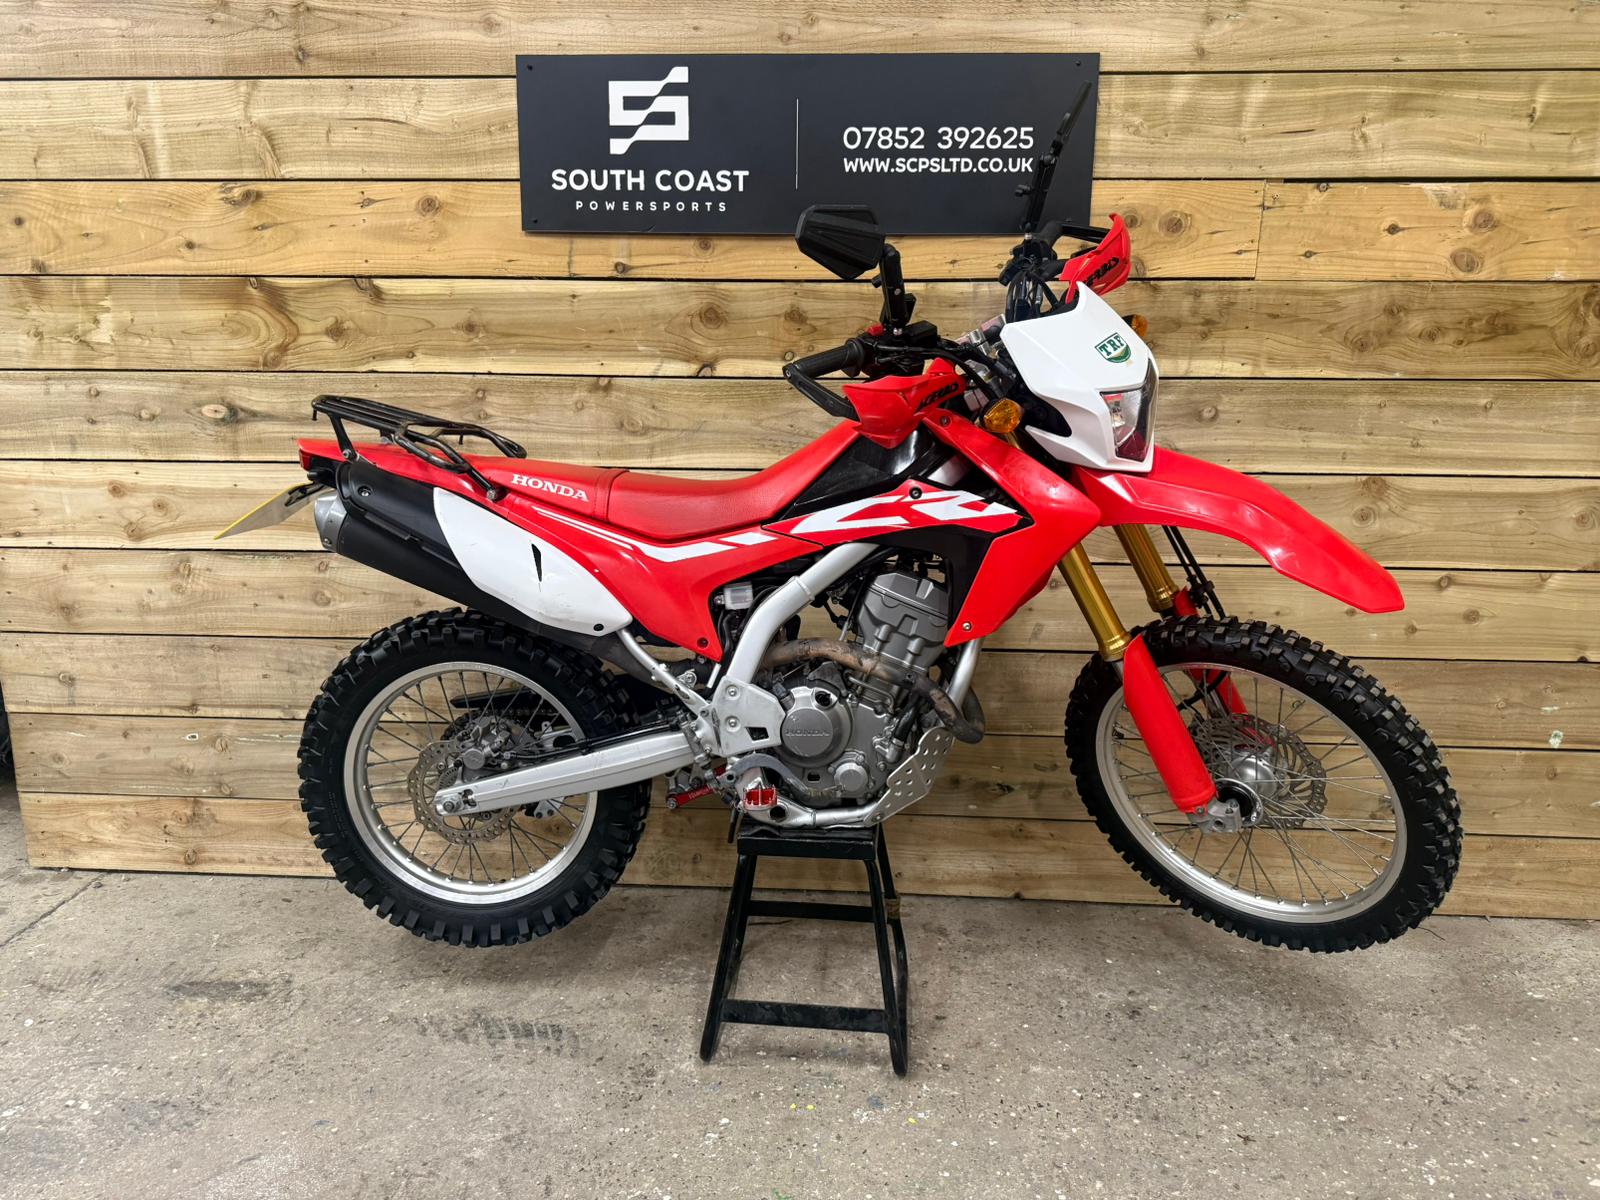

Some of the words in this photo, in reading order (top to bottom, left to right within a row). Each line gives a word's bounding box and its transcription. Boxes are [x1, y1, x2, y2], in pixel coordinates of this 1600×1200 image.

[842, 126, 925, 150] 07852
[936, 126, 1034, 150] 392625
[843, 157, 1034, 173] WWW.SCPSLTD.CO.UK
[551, 168, 645, 191] SOUTH
[654, 169, 750, 192] COAST
[575, 200, 726, 212] POWERSPORTS
[511, 473, 589, 502] HONDA
